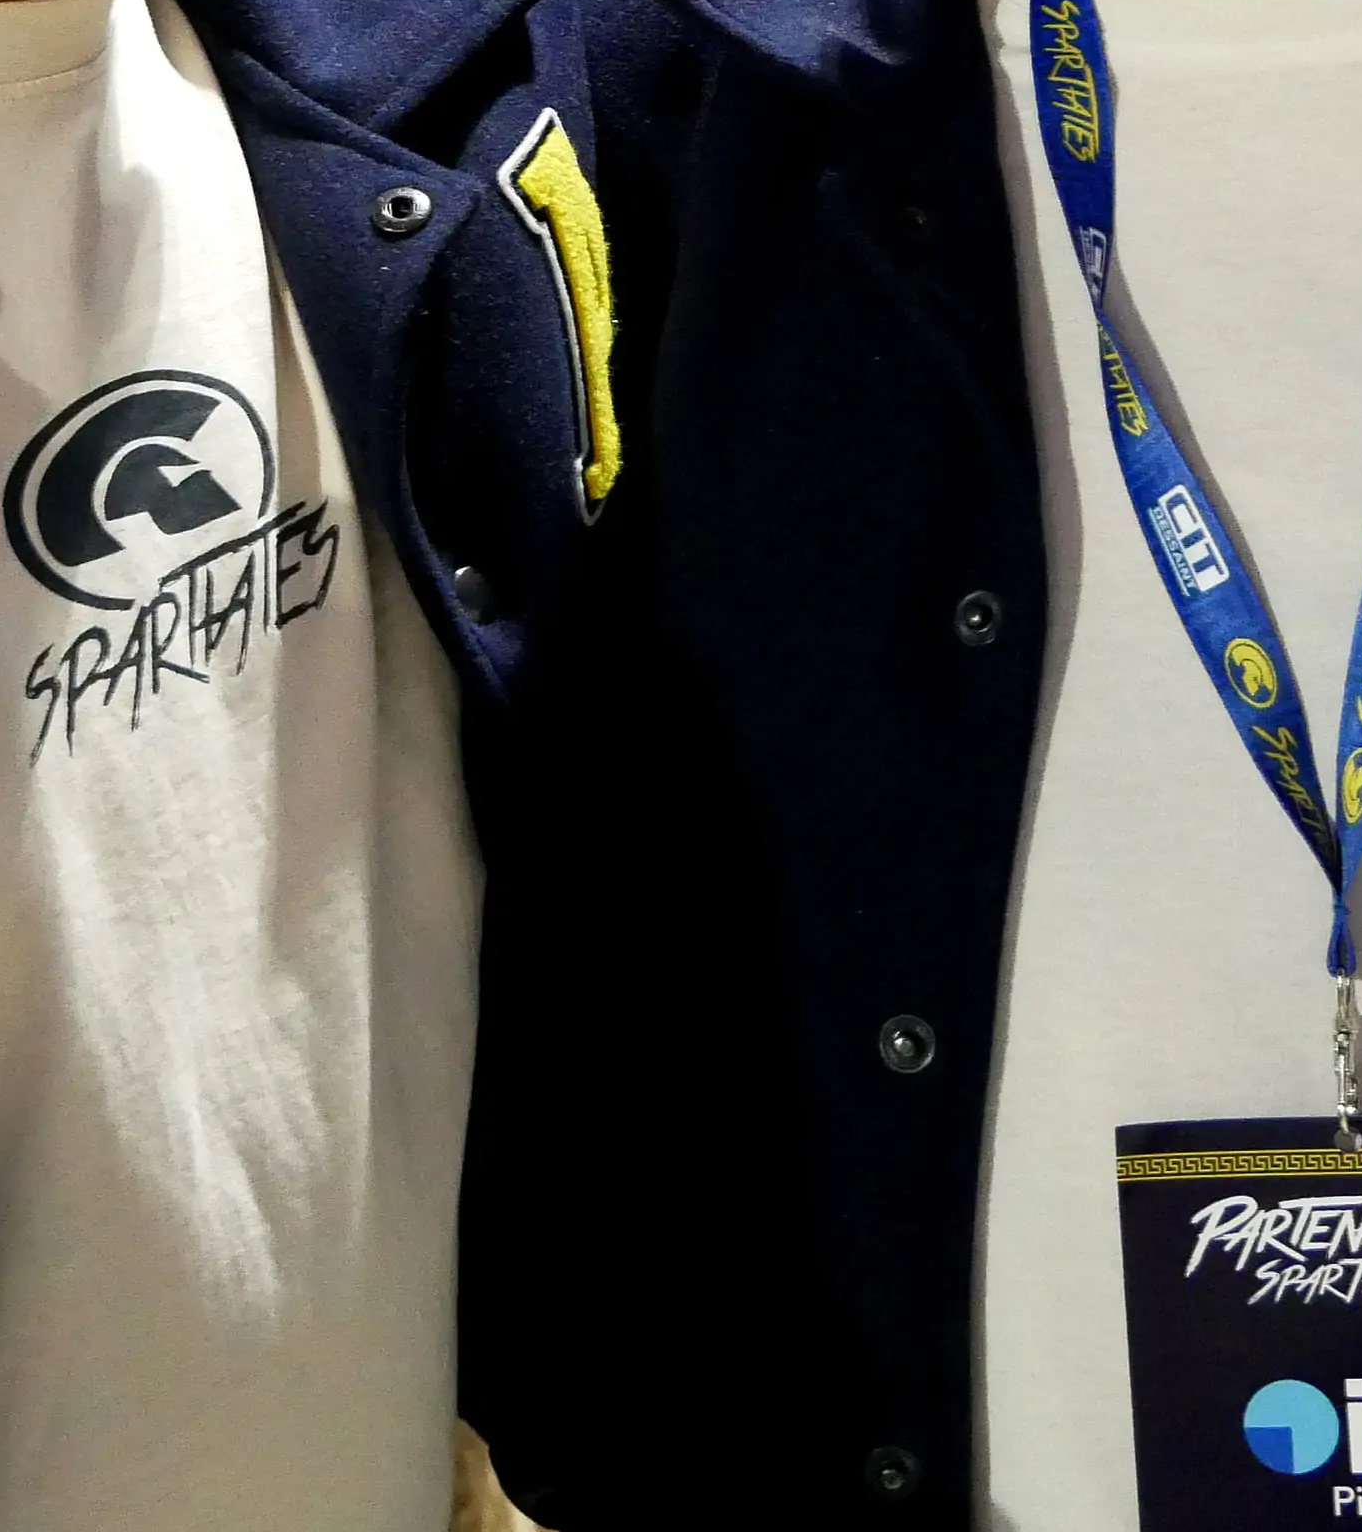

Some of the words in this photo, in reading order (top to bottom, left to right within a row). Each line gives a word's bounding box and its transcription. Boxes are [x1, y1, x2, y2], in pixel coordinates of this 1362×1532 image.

[1152, 505, 1197, 589] DESSAINT
[1164, 490, 1227, 578] CIT
[25, 496, 340, 769] SPARTIATES
